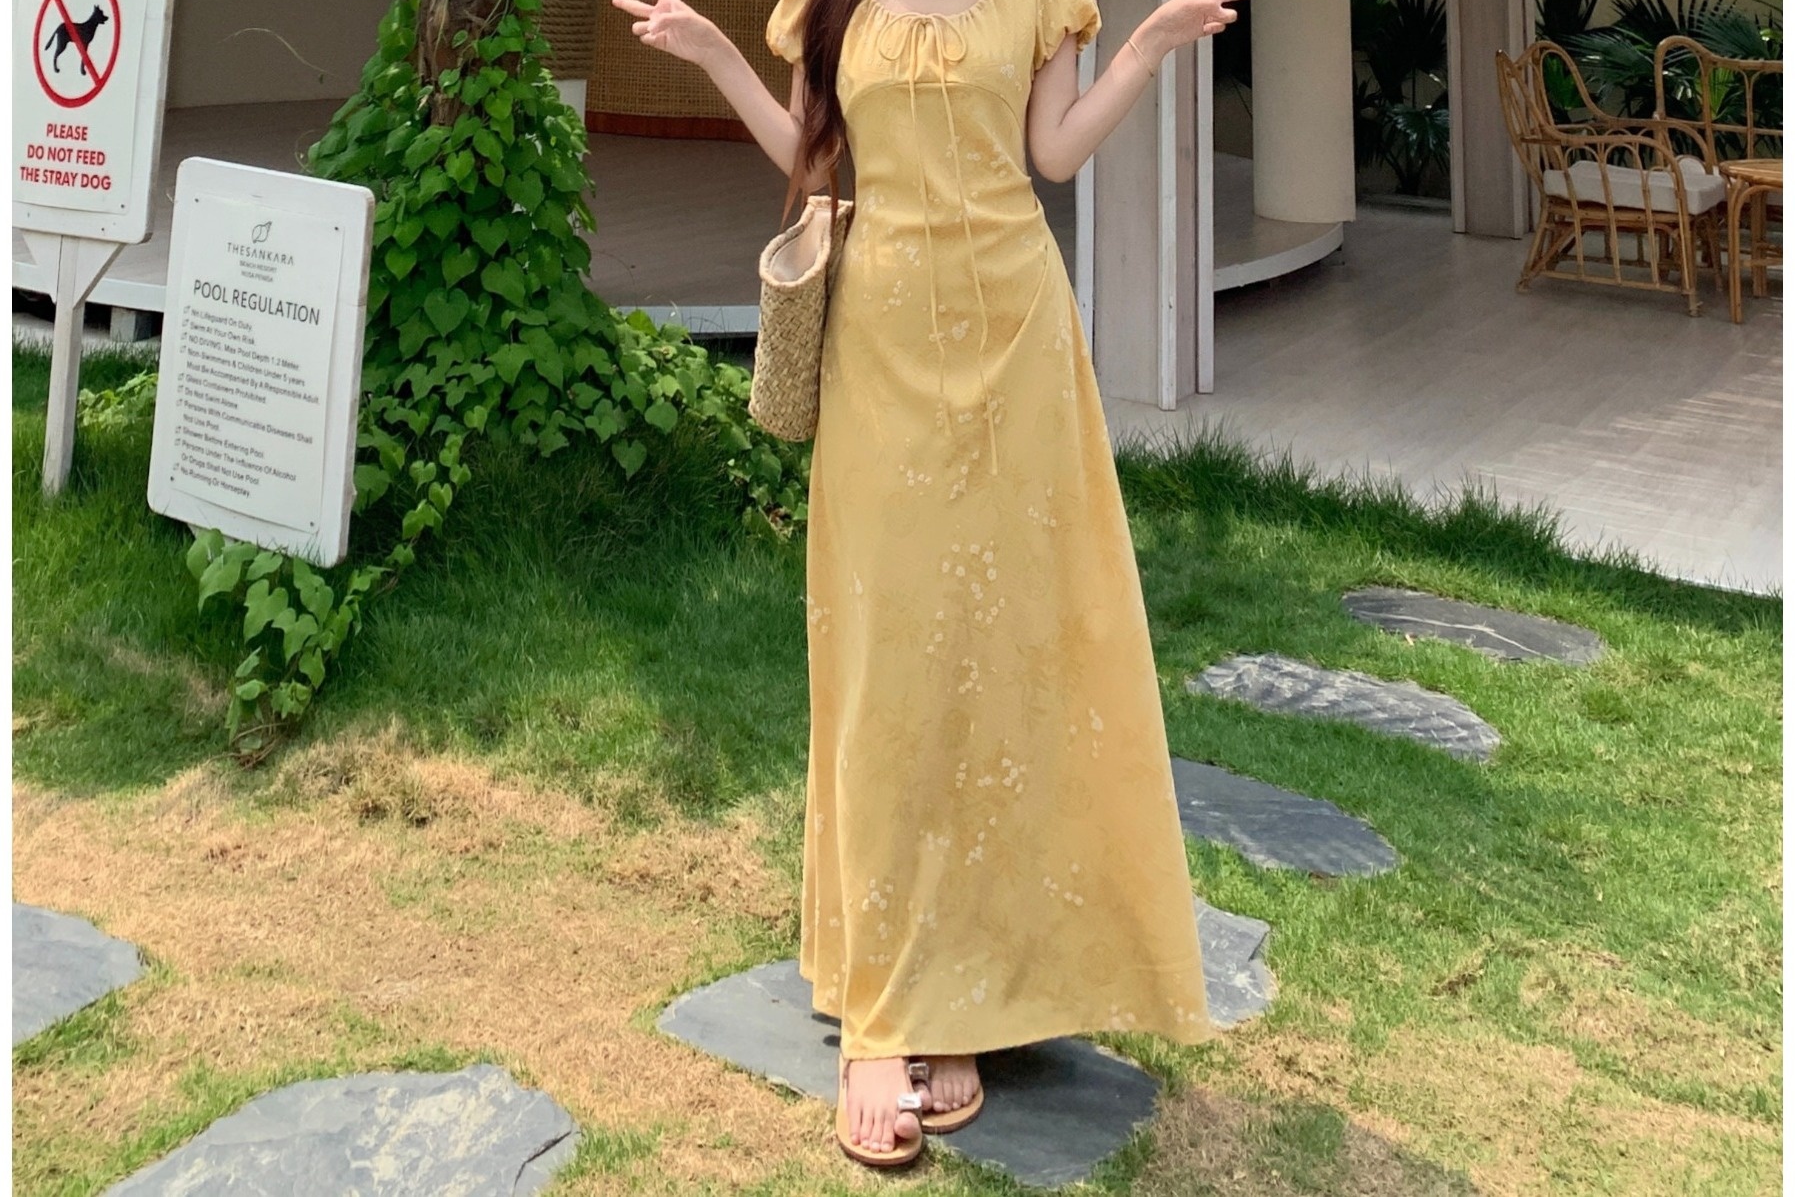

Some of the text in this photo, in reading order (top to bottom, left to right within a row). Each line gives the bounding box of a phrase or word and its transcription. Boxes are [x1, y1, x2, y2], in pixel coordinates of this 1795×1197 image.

[46, 123, 88, 141] PLEASE
[27, 144, 105, 166] DO NOT FEED
[20, 166, 112, 190] THE STRAY DOG
[194, 279, 320, 325] POOL REGULATION
[189, 334, 199, 344] NO
[237, 347, 251, 358] Pool
[227, 331, 241, 341] Own
[237, 362, 263, 374] Children
[263, 368, 283, 379] Under
[186, 373, 202, 386] Glass
[202, 379, 234, 395] Containers
[250, 378, 258, 389] By
[264, 382, 302, 399] Responsible
[223, 439, 249, 456] Entering
[223, 452, 235, 463] The
[272, 468, 297, 482] Alcohol
[232, 470, 245, 480] Use
